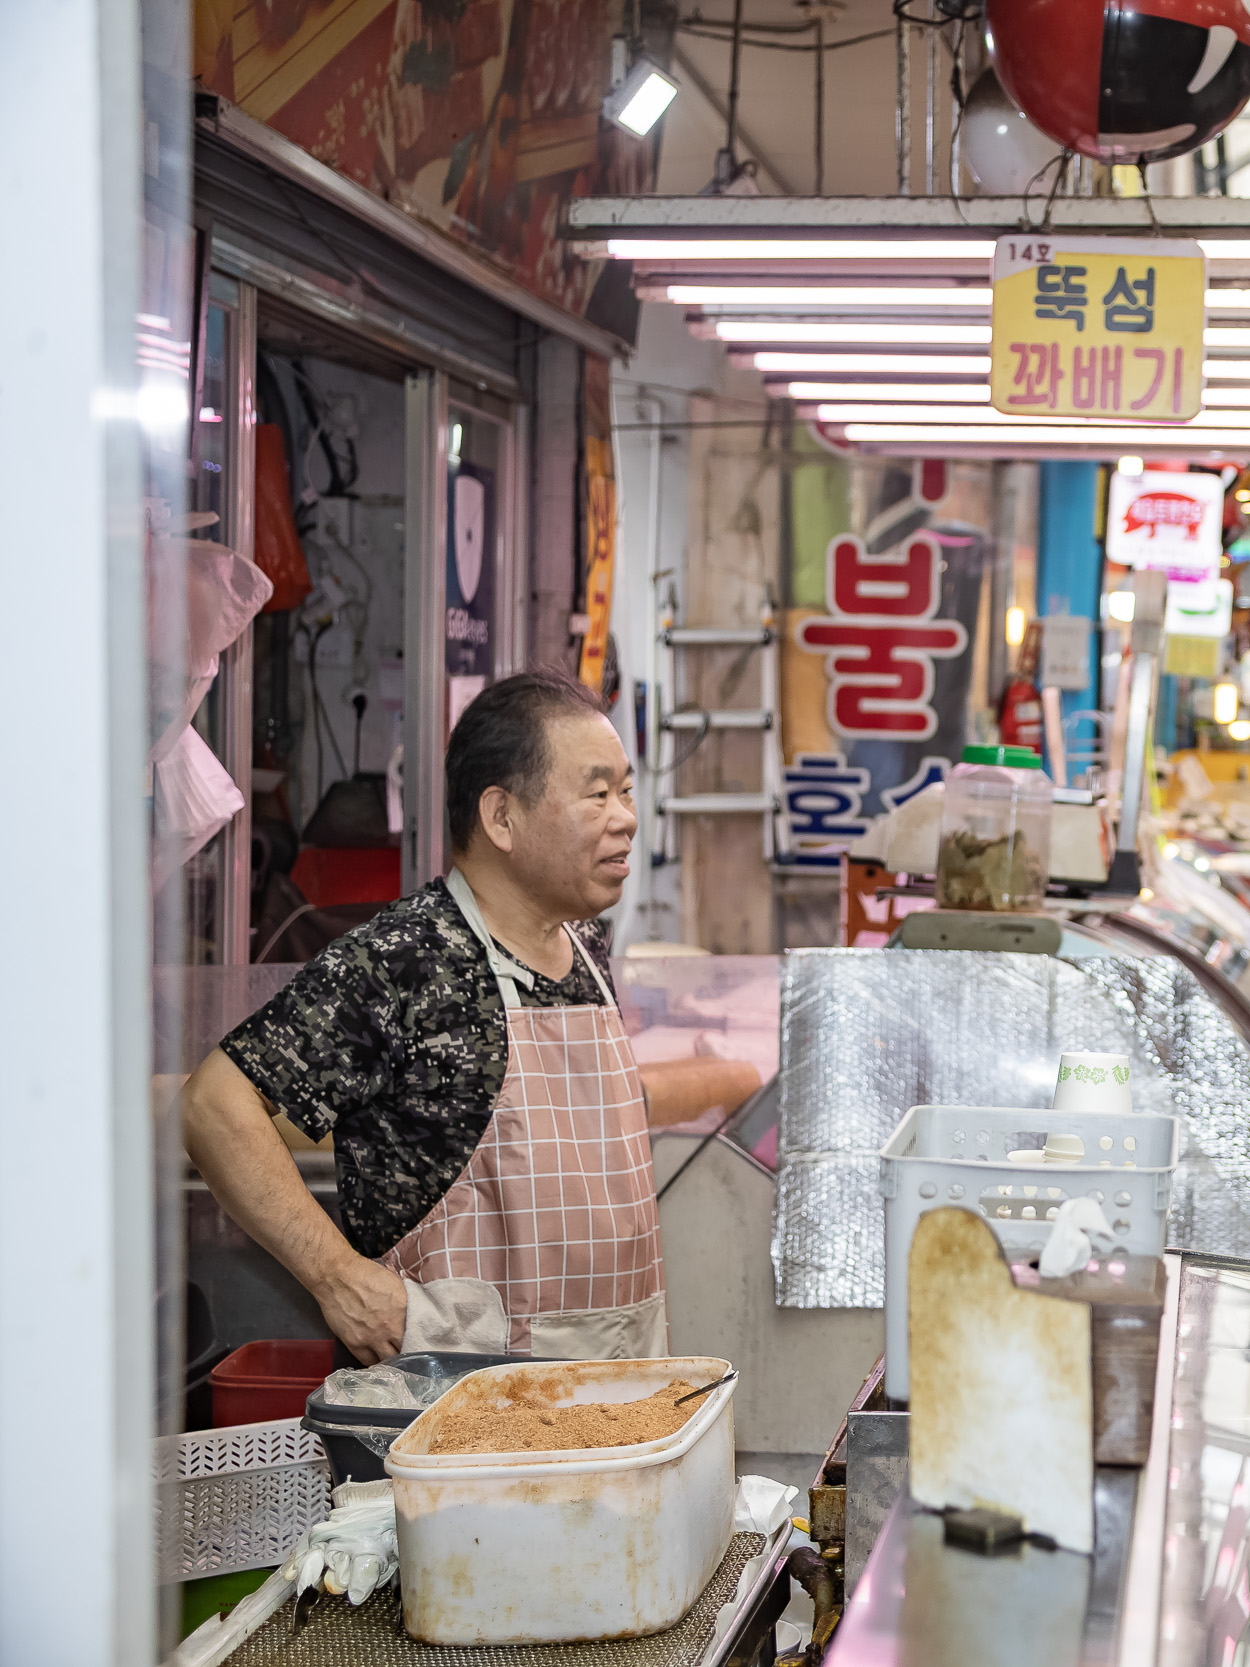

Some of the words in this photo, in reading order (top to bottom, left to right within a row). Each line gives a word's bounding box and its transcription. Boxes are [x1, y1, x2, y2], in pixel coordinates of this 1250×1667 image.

[1008, 243, 1051, 263] 14호
[1034, 265, 1156, 332] 뚝섬
[1007, 341, 1184, 414] 꽈배기
